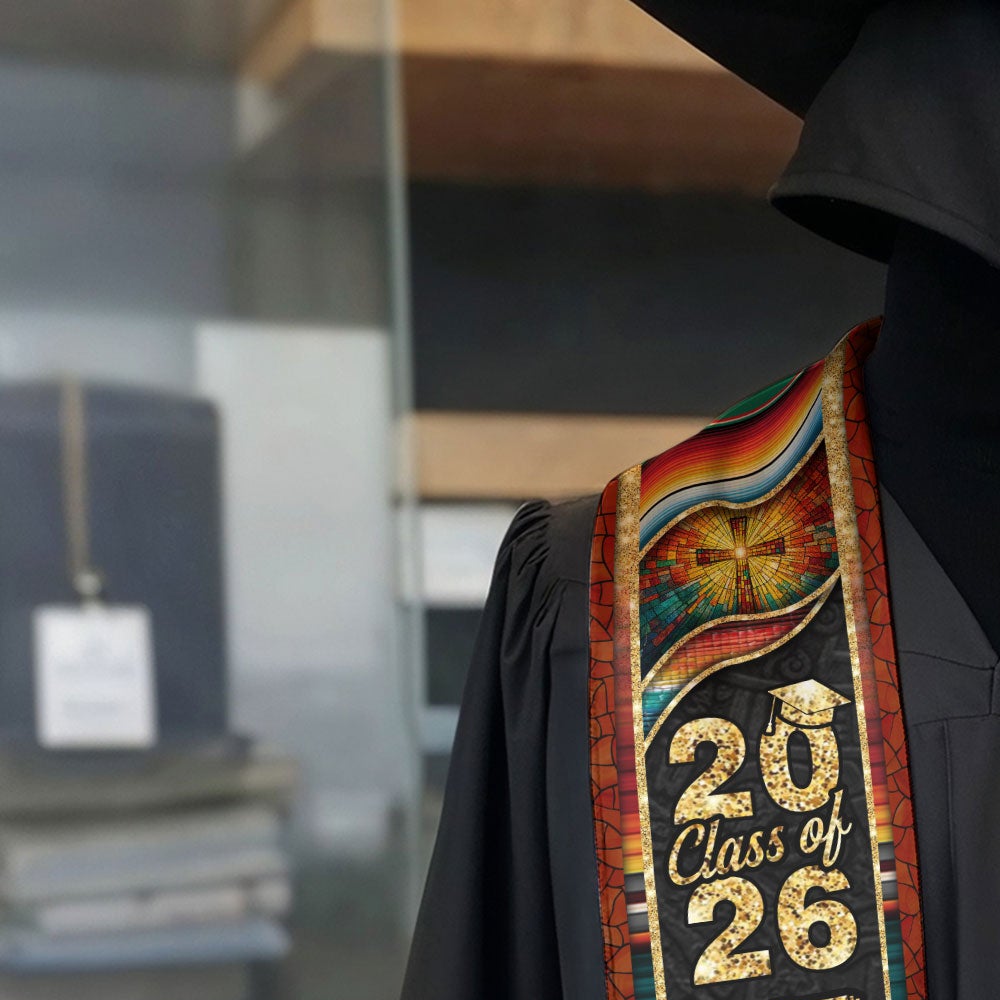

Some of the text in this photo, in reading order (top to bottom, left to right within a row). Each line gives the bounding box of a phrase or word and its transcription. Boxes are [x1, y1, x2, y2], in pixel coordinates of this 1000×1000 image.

[669, 717, 839, 825] 20
[668, 789, 852, 886] Class of
[687, 865, 857, 985] 26
